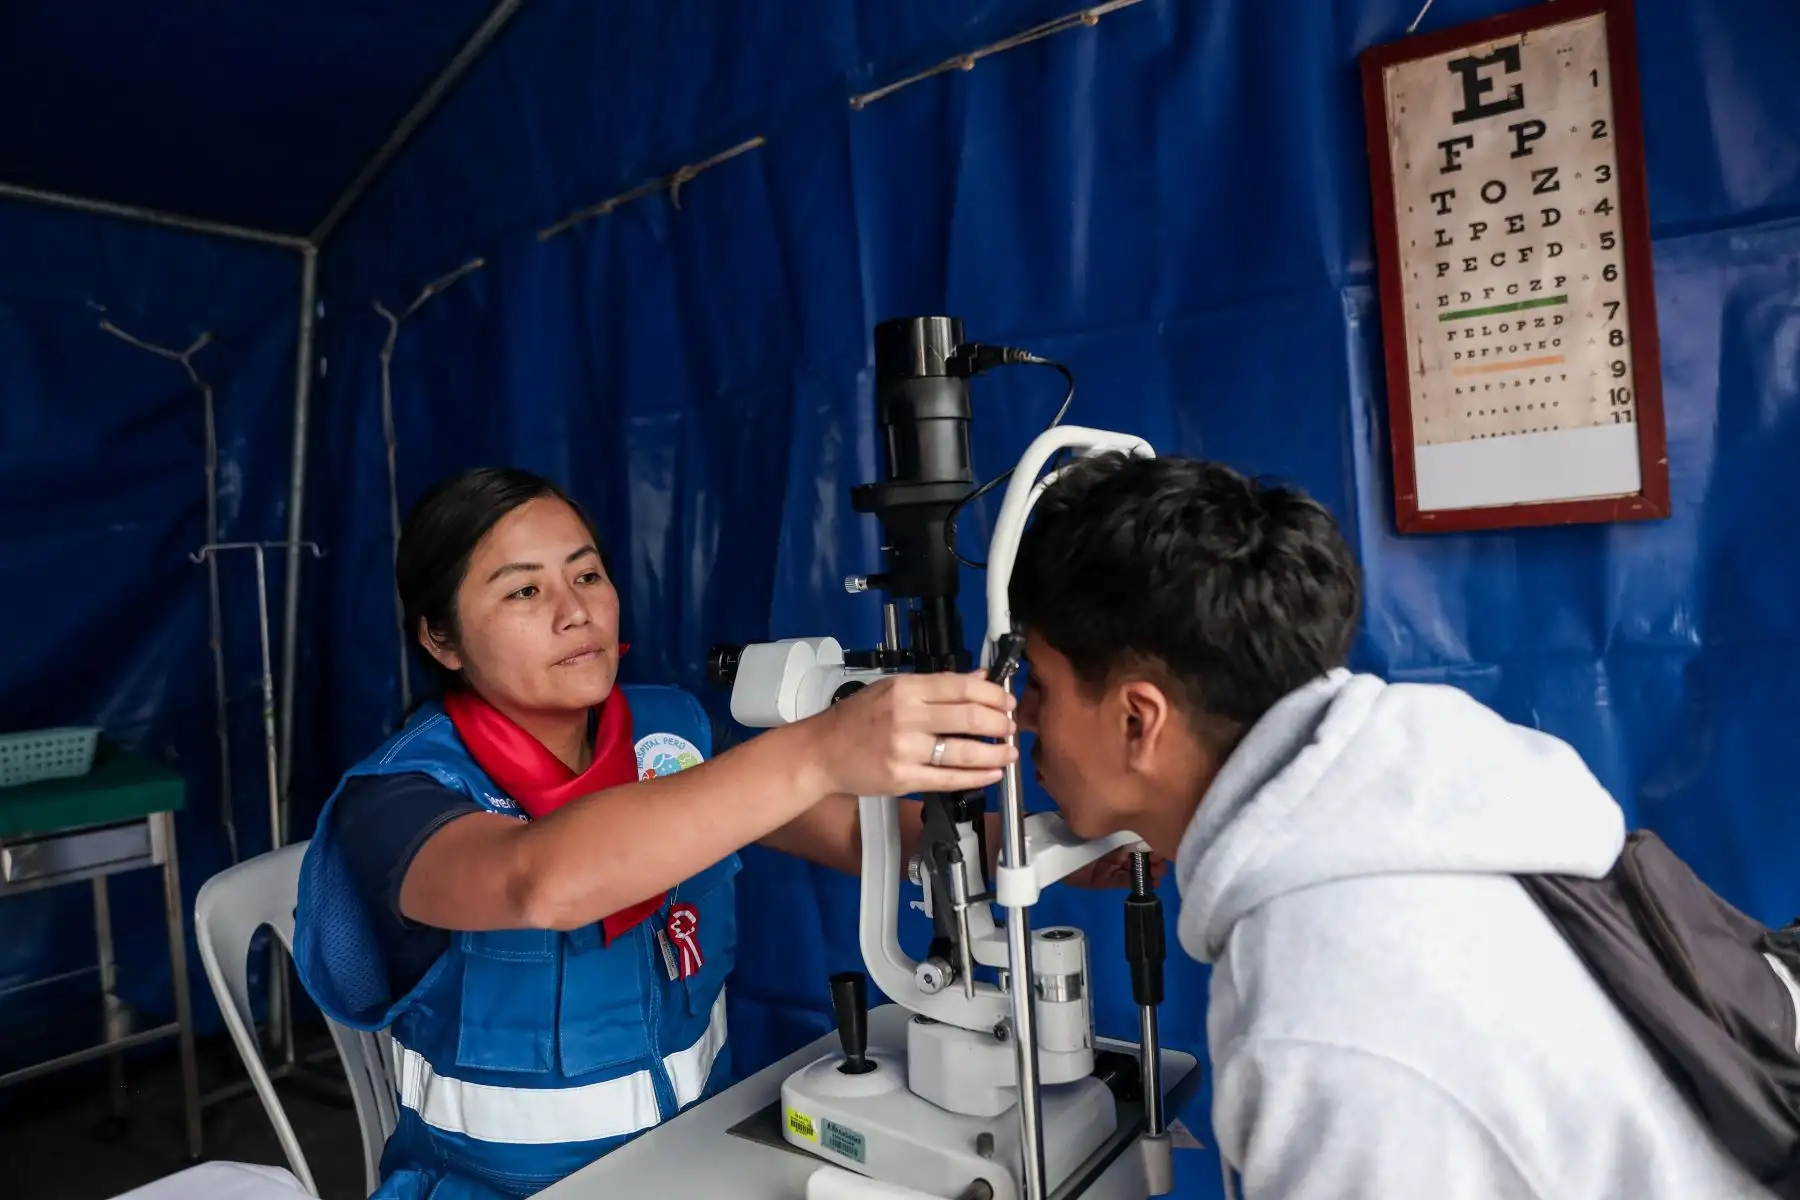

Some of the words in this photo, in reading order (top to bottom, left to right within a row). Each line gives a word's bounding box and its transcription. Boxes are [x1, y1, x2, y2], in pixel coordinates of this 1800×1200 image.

[1447, 43, 1525, 125] E
[1588, 68, 1599, 88] 1
[1590, 119, 1608, 140] 2
[1437, 134, 1474, 175] F
[1508, 119, 1547, 159] P
[1593, 164, 1612, 184] 3
[1430, 188, 1456, 216] T
[1481, 180, 1507, 204] O
[1531, 167, 1560, 195] Z
[1593, 197, 1614, 217] 4
[1434, 229, 1453, 248] L
[1469, 222, 1488, 241] P
[1504, 214, 1525, 235] E
[1541, 208, 1561, 227] D
[1599, 231, 1616, 251] 5
[1436, 262, 1450, 278] P
[1462, 257, 1478, 272] E
[1490, 252, 1506, 267] C
[1518, 246, 1533, 263] F
[1546, 242, 1563, 258] D
[1602, 263, 1619, 283] 6
[1603, 300, 1621, 321] 7
[1608, 328, 1625, 348] 8
[1610, 359, 1627, 379] 9
[1608, 386, 1631, 407] 10
[636, 738, 661, 769] HOSPITAL
